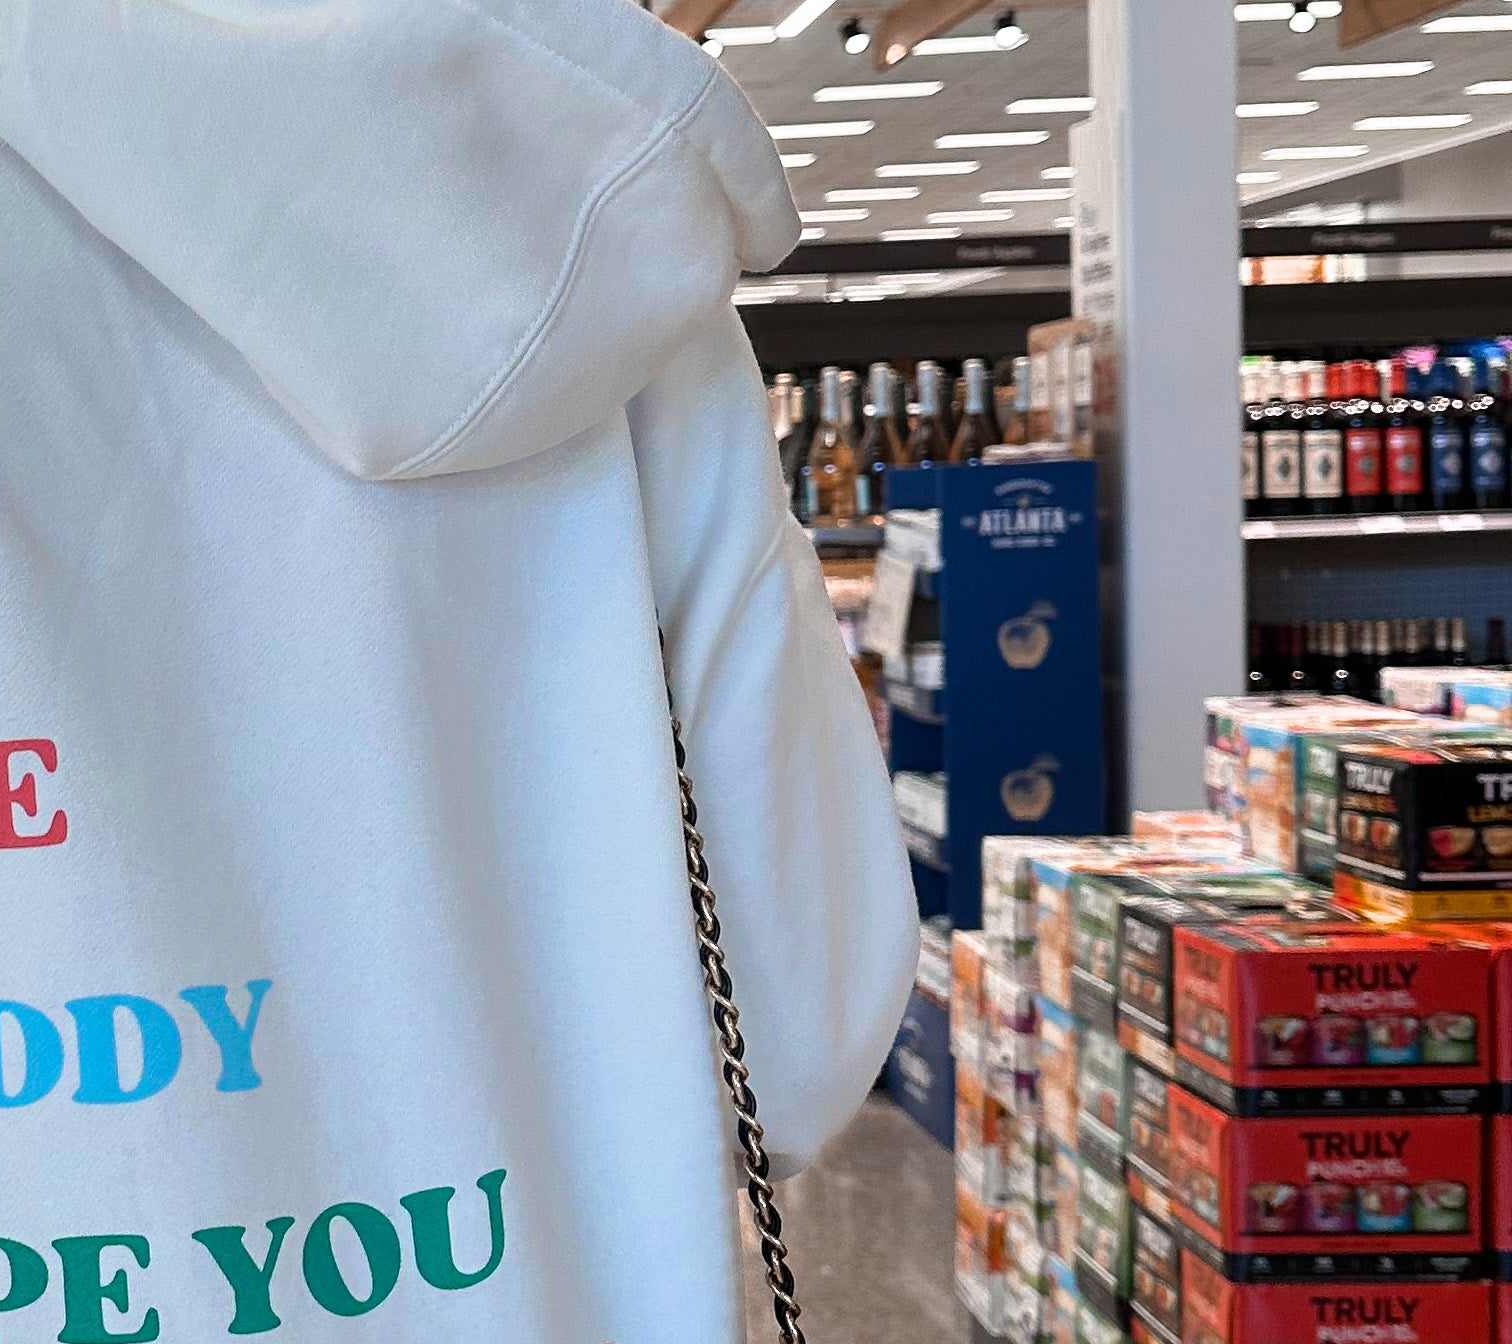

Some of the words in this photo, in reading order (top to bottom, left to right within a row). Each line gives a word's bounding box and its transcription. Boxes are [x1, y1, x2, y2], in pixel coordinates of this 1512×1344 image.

[979, 507, 1066, 536] ATLANTA
[1309, 962, 1419, 991] TRULY
[1301, 1130, 1412, 1158] TRULY
[191, 1168, 507, 1336] YOU
[1311, 1296, 1419, 1325] TRULY
